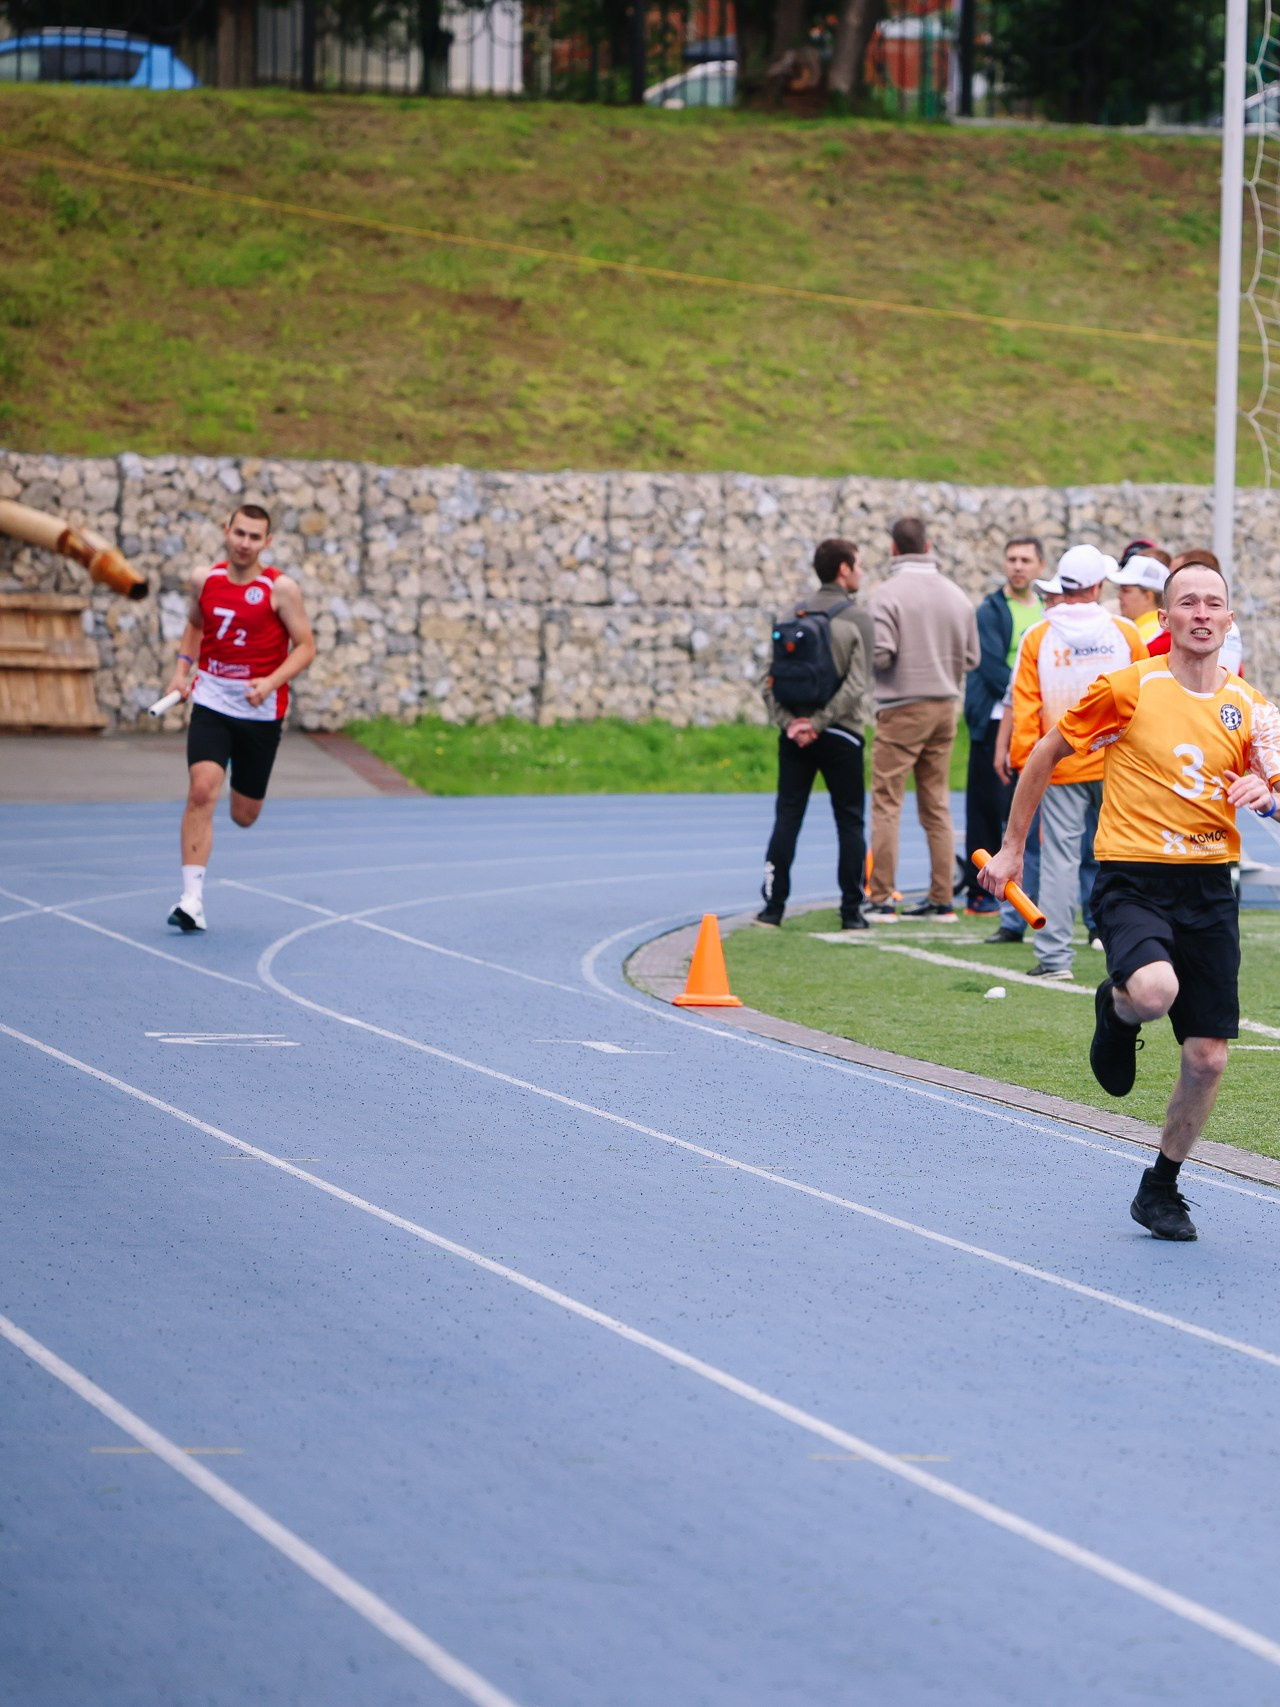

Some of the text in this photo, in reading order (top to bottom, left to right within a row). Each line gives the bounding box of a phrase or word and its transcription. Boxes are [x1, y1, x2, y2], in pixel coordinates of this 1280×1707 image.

[213, 607, 247, 646] 7 2
[1173, 743, 1224, 800] 3 2
[1189, 830, 1228, 844] КОМОС
